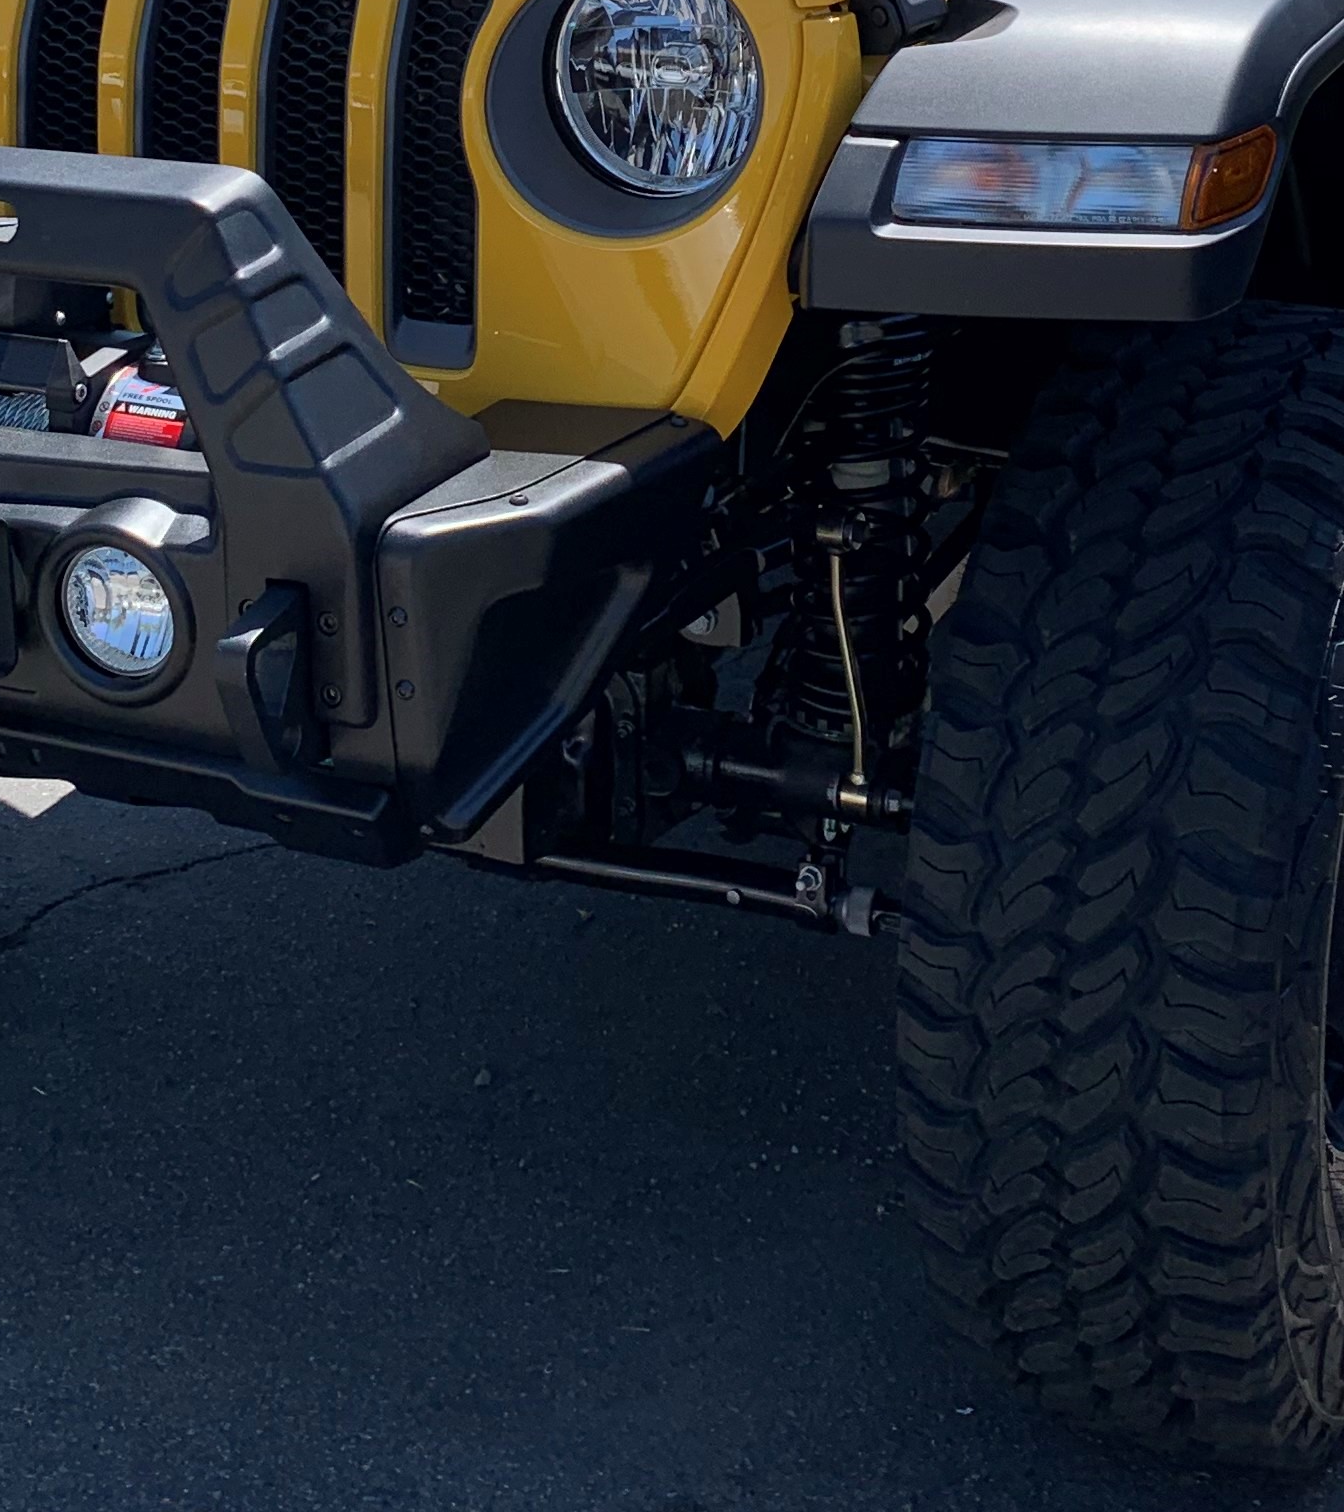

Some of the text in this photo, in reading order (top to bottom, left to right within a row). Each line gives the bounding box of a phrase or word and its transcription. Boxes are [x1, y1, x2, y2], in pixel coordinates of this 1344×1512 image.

[122, 391, 174, 405] FREE SPOOL
[128, 404, 177, 420] WARNING
